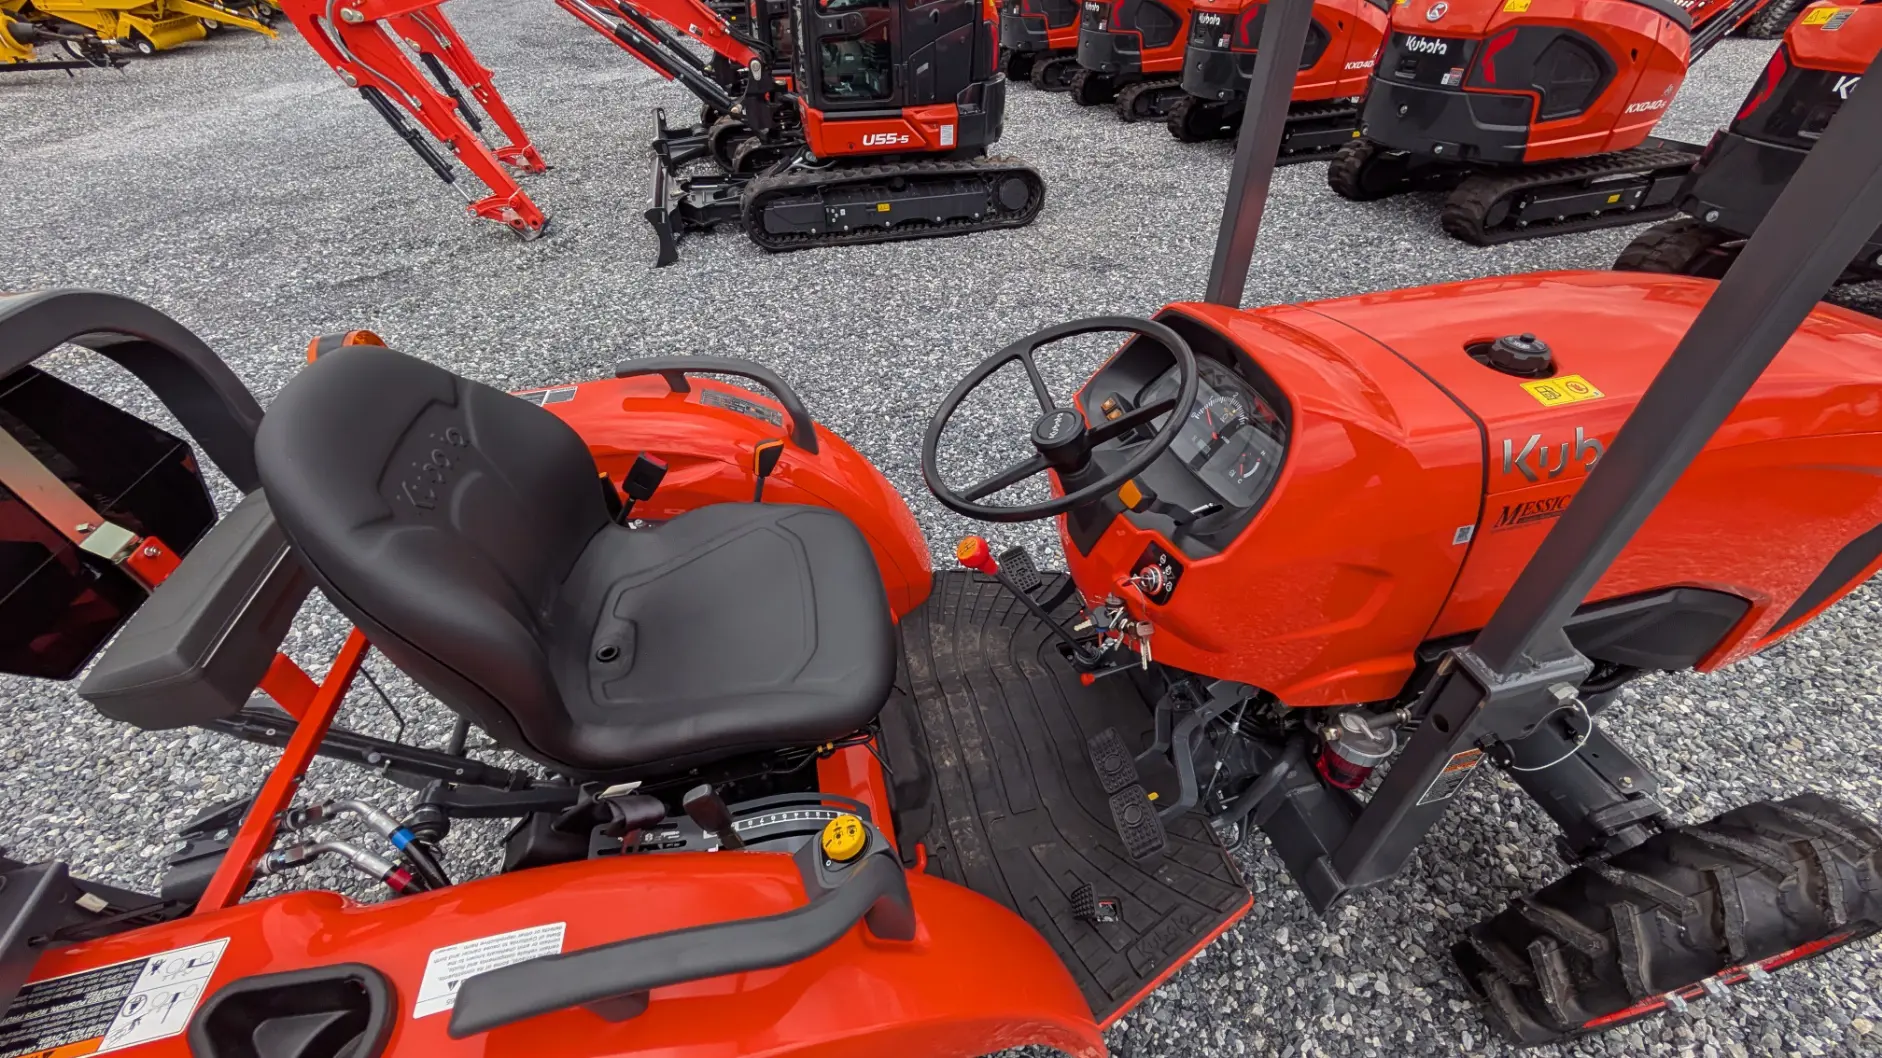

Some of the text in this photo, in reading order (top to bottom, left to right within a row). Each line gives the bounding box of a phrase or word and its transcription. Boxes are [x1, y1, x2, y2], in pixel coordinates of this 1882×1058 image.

[1405, 35, 1448, 55] Kubota
[1503, 426, 1605, 483] Kub
[1494, 495, 1571, 529] MESSIC
[22, 1007, 47, 1020] ROPS
[86, 1020, 110, 1032] FROM
[93, 1027, 106, 1036] TO
[66, 1030, 94, 1043] AVOID
[20, 1044, 36, 1055] OR
